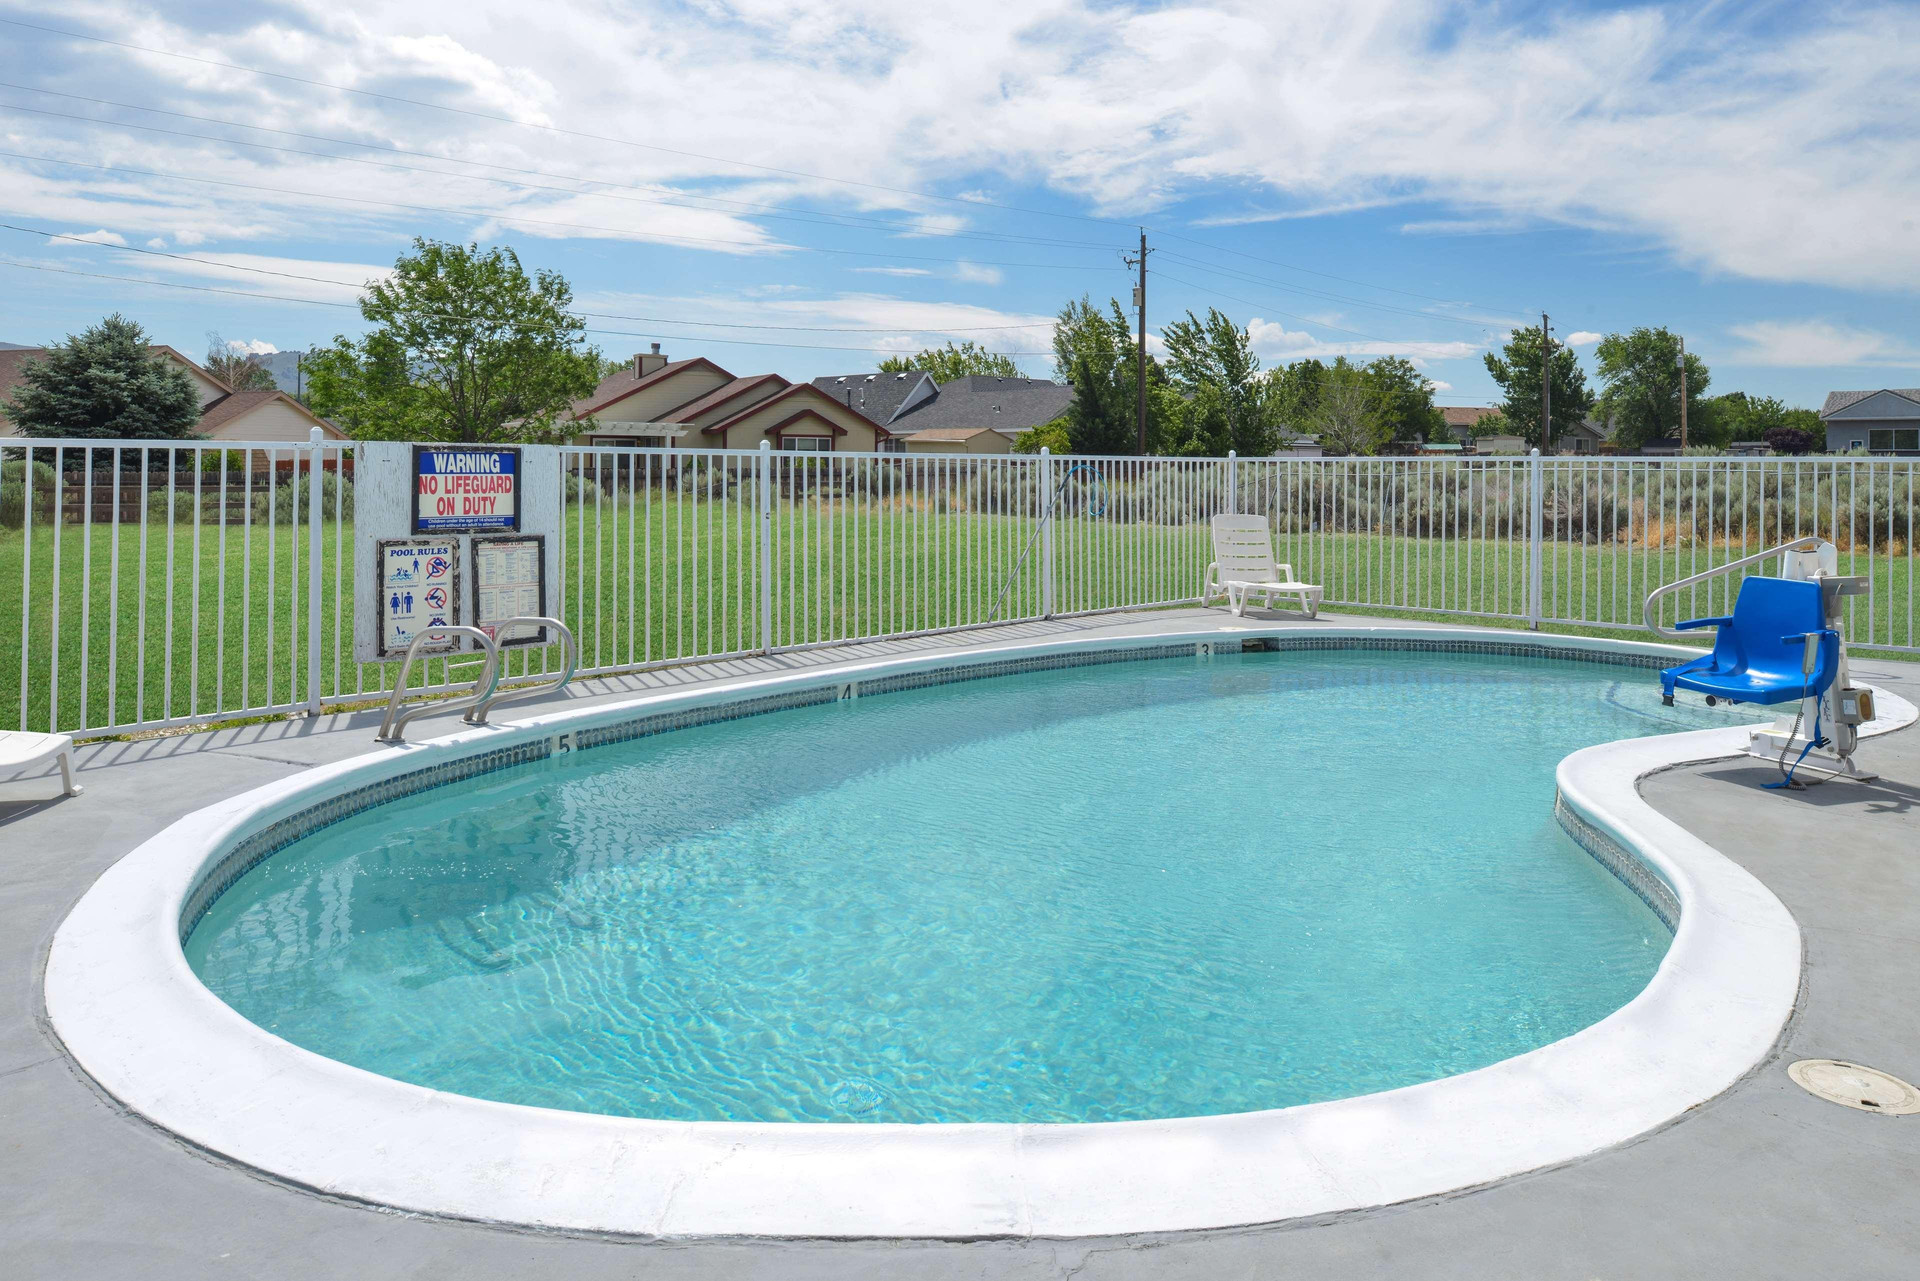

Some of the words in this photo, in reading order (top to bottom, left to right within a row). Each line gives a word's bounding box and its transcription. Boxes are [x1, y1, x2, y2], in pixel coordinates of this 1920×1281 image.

[433, 454, 500, 473] WARNING
[419, 476, 438, 494] NO
[444, 476, 512, 494] LIFEGUARD
[436, 496, 455, 516] ON
[463, 496, 496, 515] DUTY
[390, 549, 415, 557] POOL
[418, 548, 448, 556] RULES
[1202, 643, 1209, 655] 3
[842, 684, 851, 700] 4
[558, 734, 570, 754] 5
